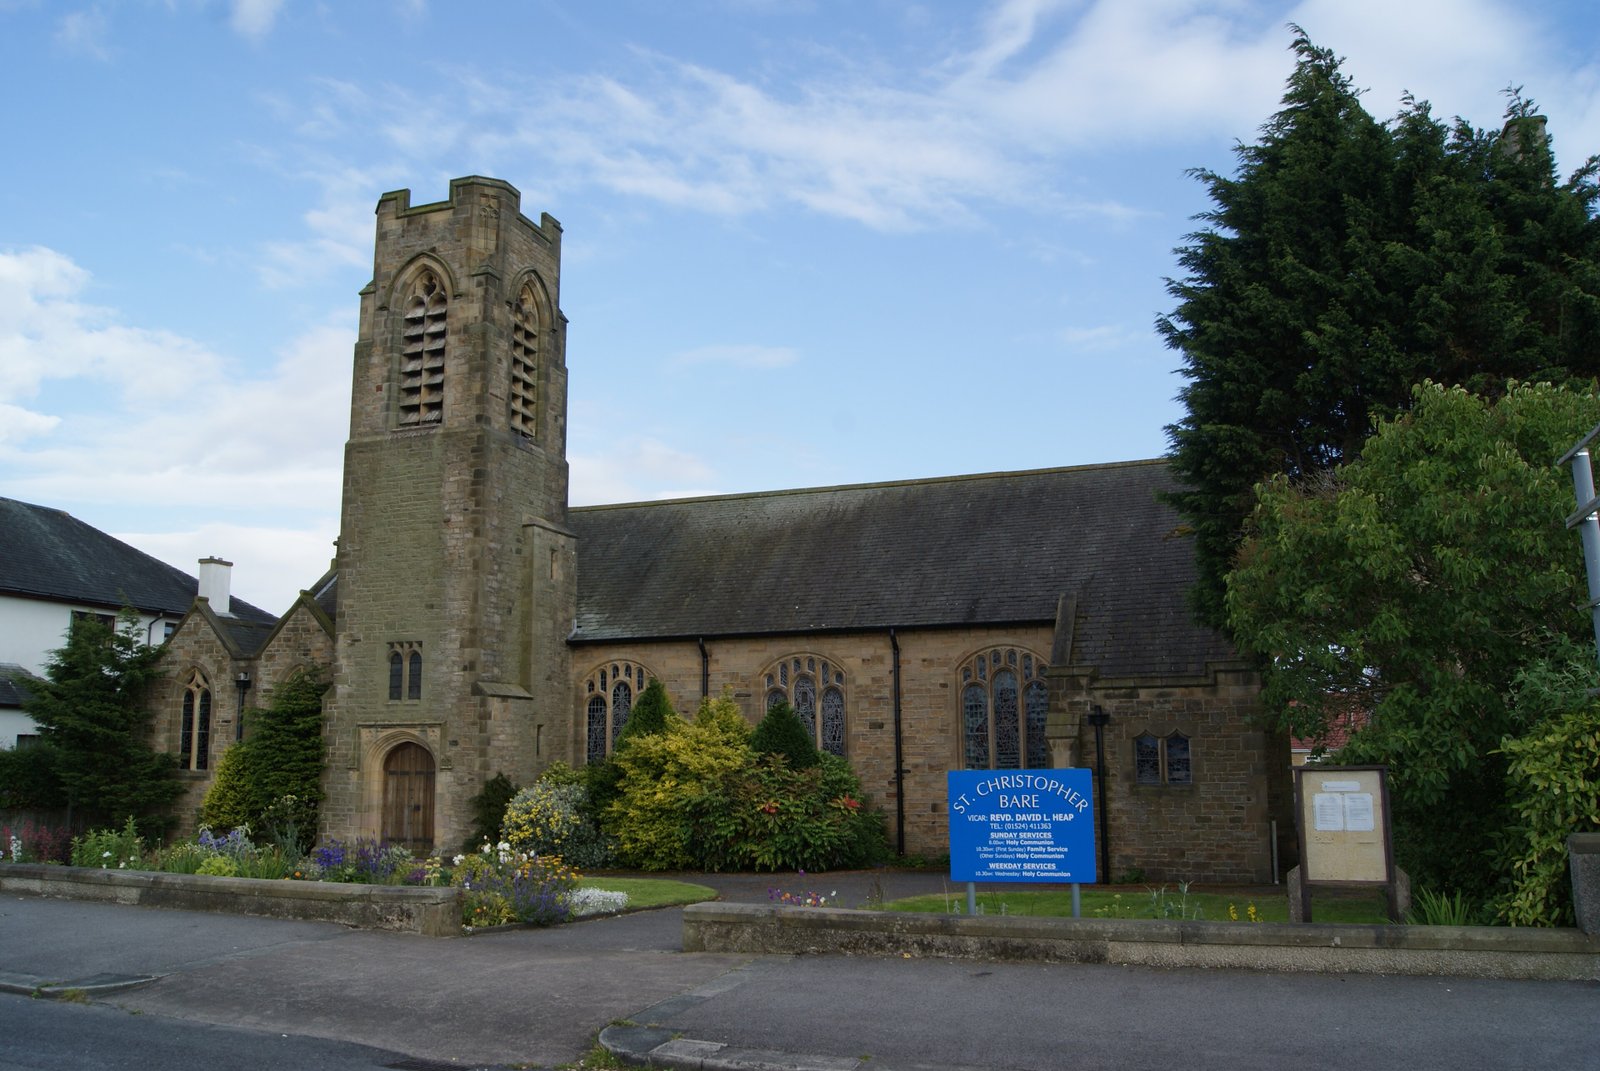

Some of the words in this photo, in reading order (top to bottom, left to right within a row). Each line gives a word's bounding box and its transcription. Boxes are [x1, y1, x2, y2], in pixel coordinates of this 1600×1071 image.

[953, 793, 976, 814] ST.
[976, 774, 1089, 813] CHRISTOPHER
[999, 794, 1040, 808] BARE
